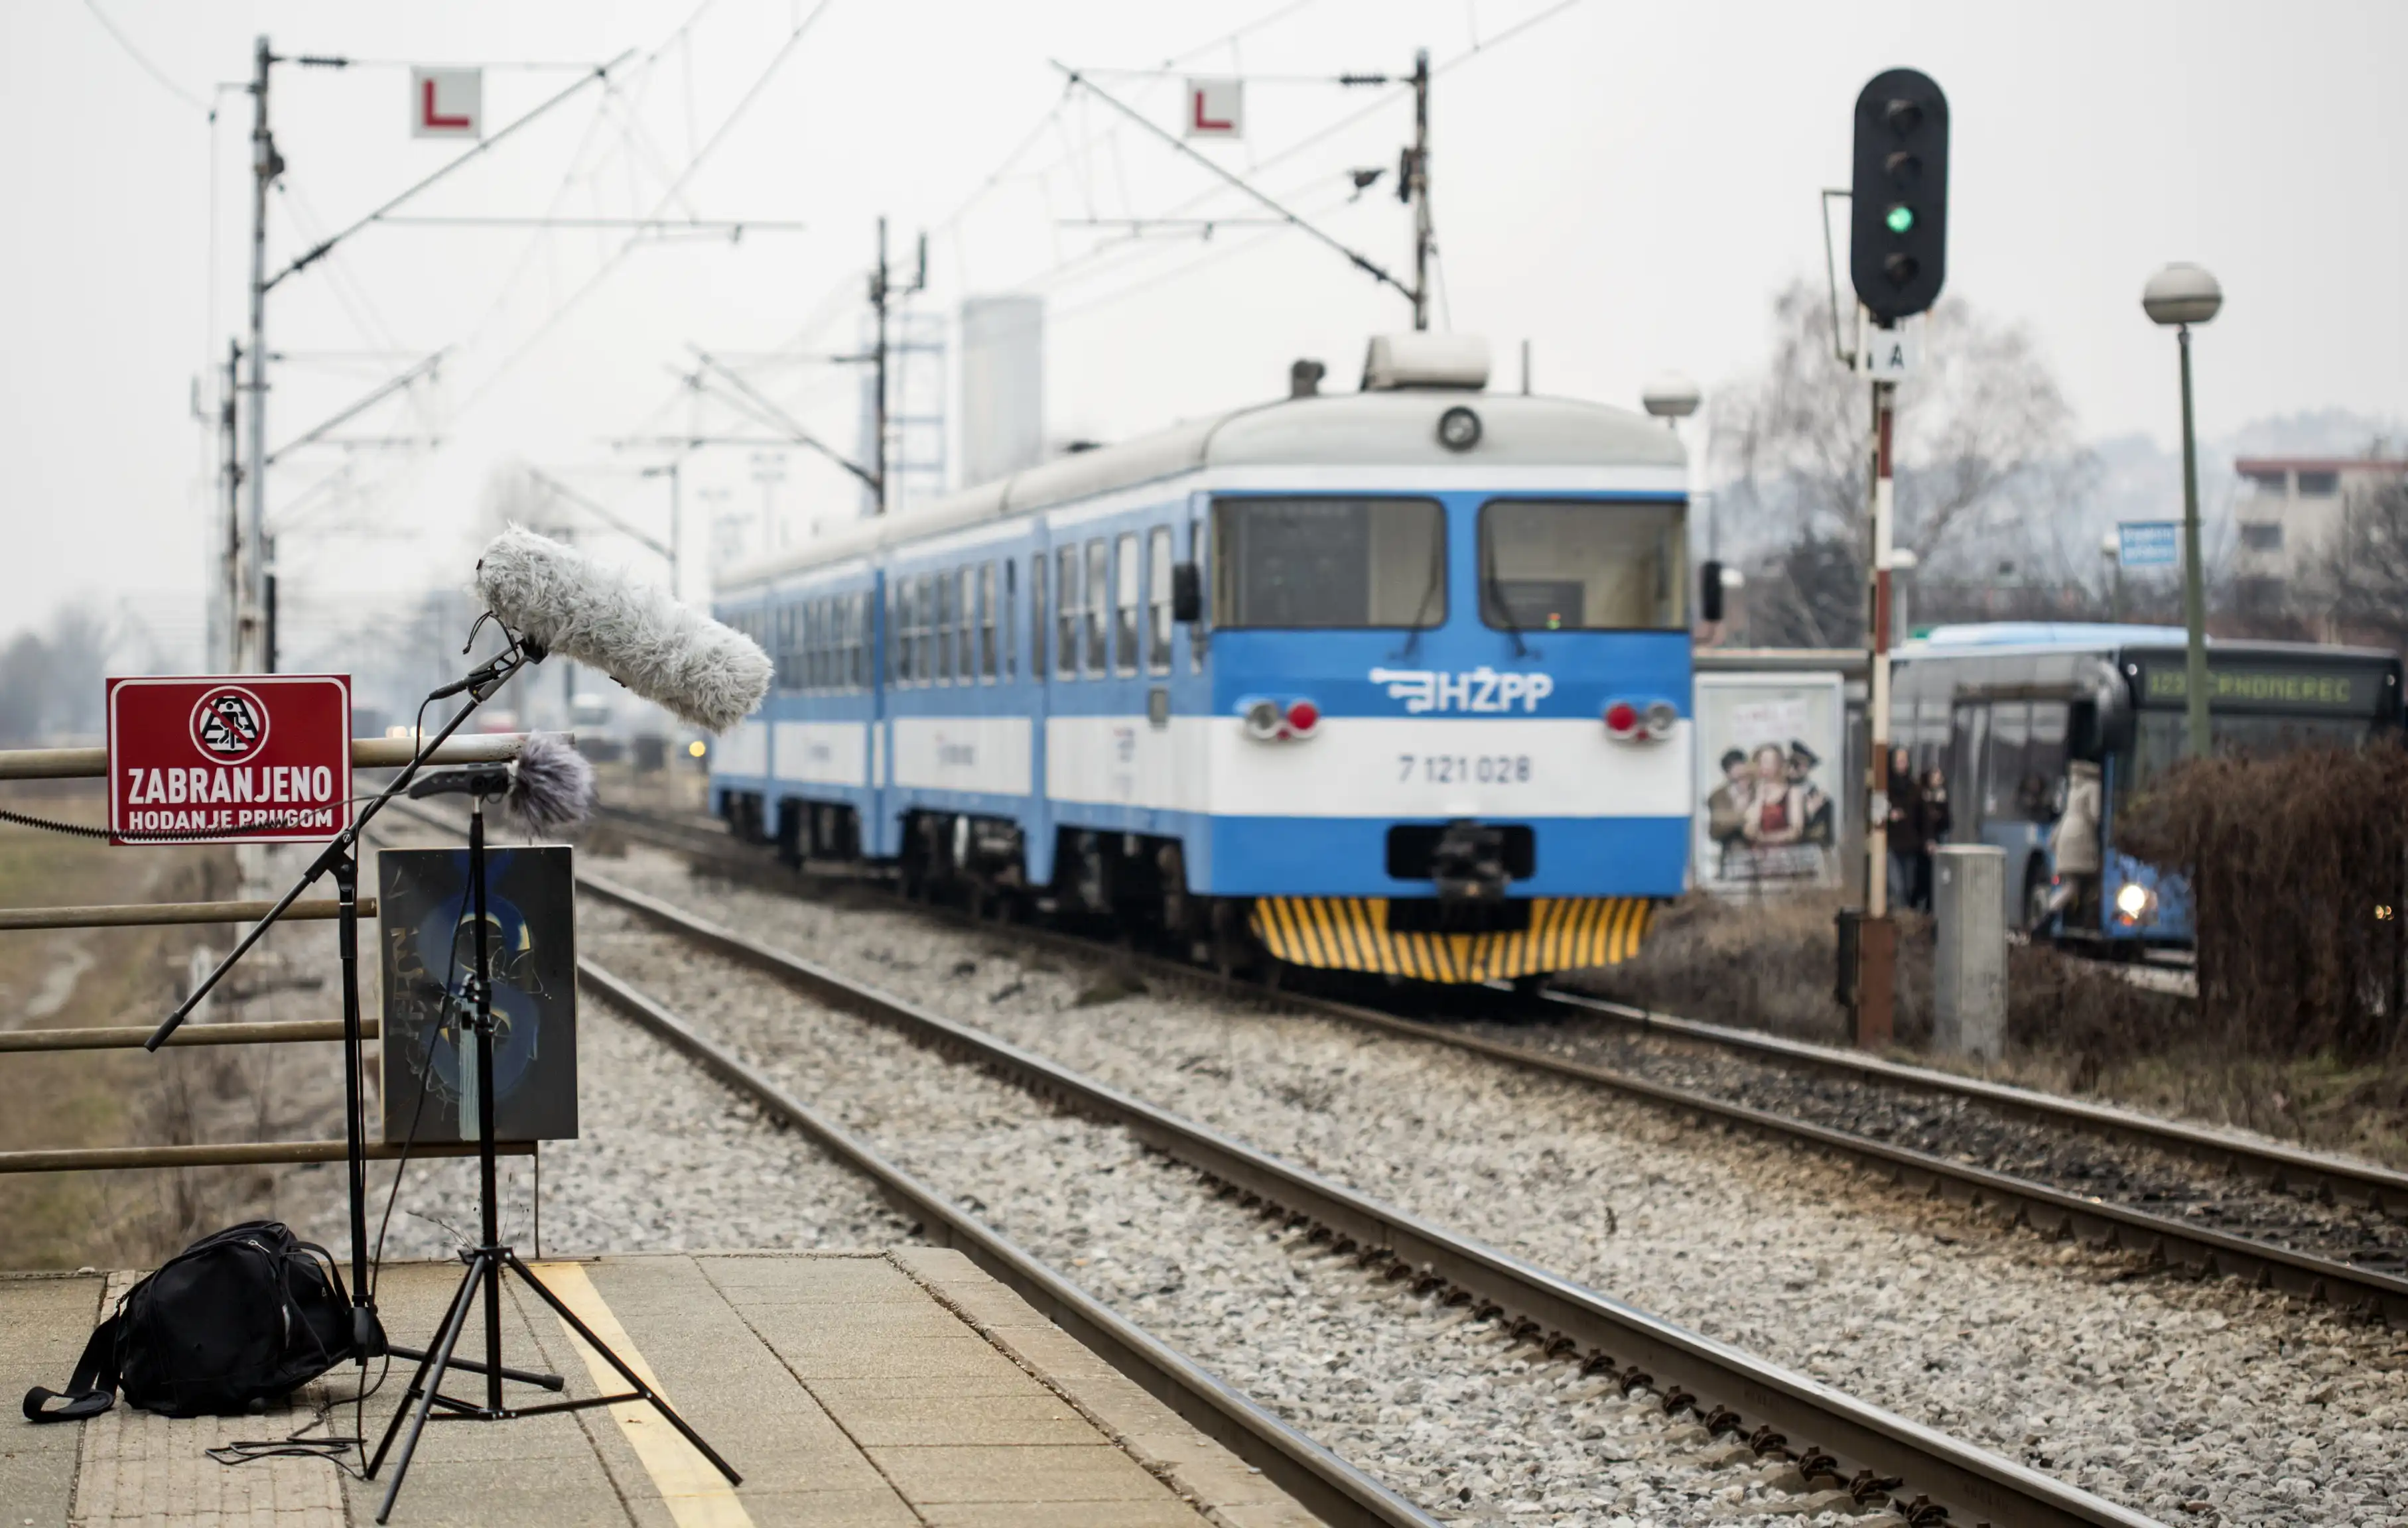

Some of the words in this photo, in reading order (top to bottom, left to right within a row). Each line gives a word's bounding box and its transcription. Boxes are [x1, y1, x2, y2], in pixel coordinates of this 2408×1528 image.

[1890, 342, 1905, 369] A
[1438, 666, 1554, 712] HŽPP
[128, 766, 332, 804] ZABRANJENO
[129, 810, 232, 829] HODANJE
[239, 808, 332, 828] PRUGOM
